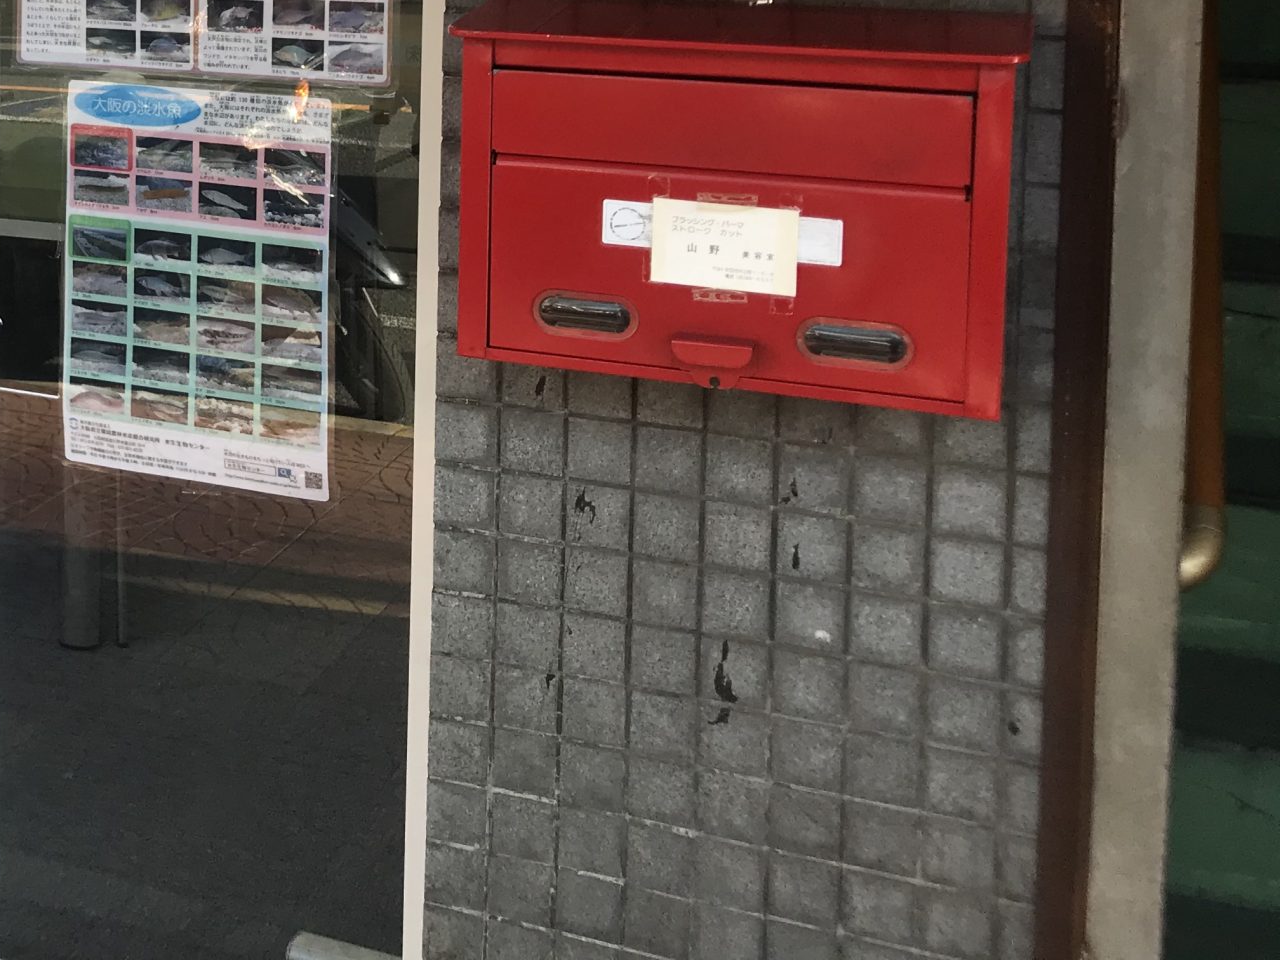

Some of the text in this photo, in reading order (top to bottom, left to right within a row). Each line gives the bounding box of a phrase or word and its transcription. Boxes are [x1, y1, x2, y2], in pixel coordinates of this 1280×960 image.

[93, 98, 182, 118] 大阪の淡水魚
